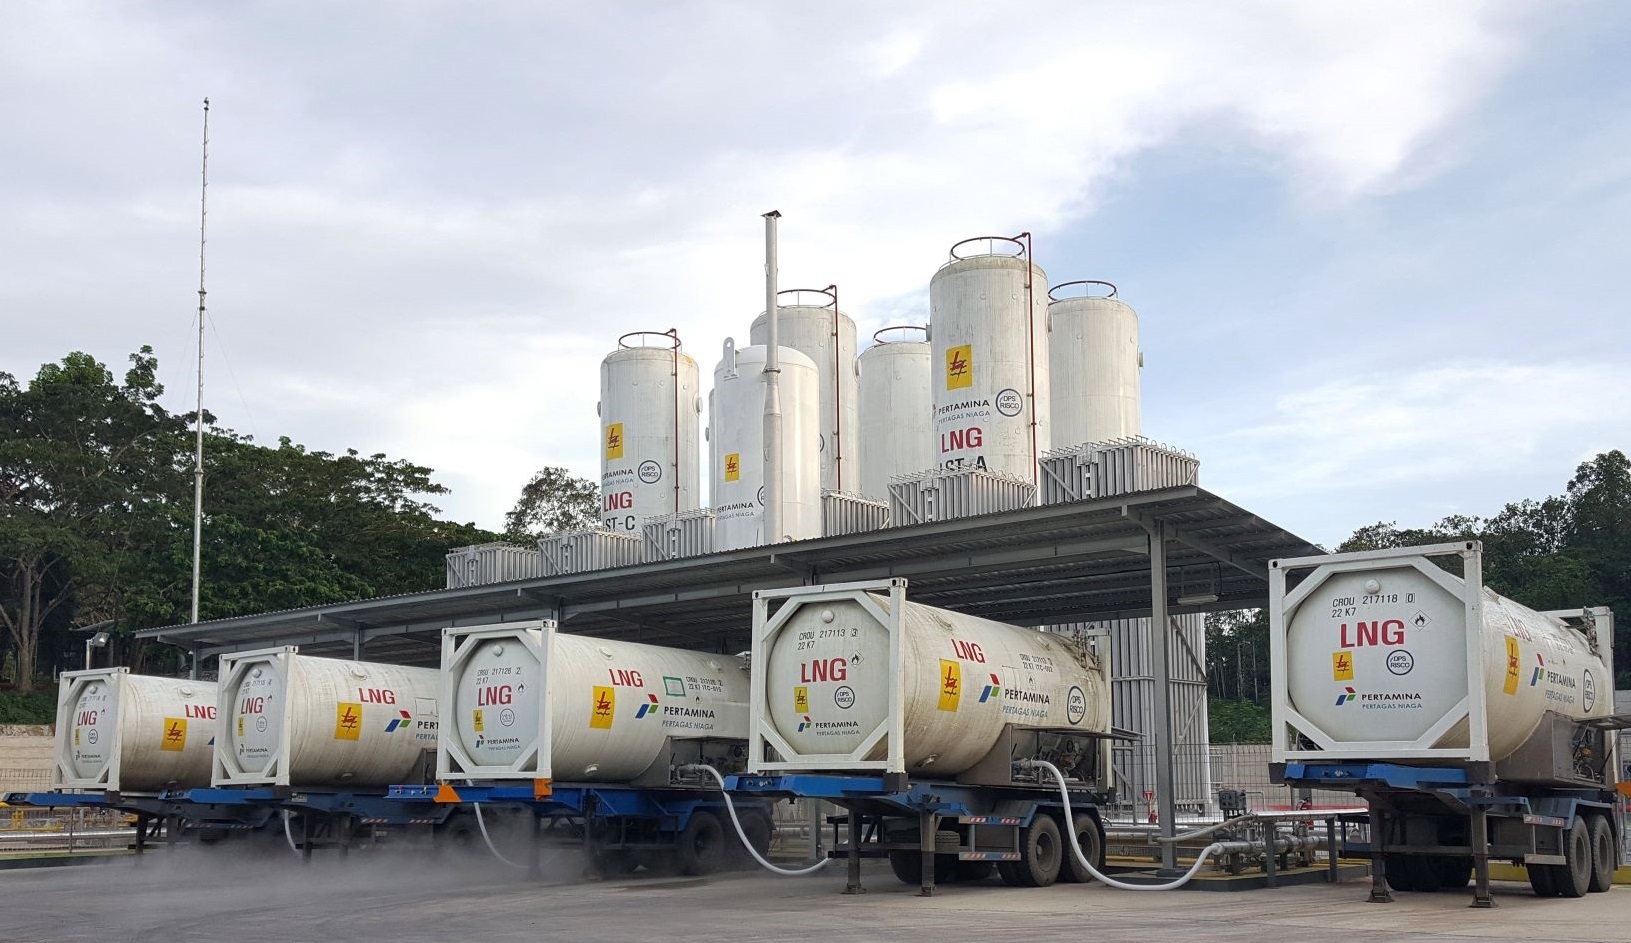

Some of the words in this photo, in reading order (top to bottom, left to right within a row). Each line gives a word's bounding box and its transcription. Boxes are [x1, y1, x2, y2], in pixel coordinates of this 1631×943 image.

[938, 400, 990, 415] PERTAMINA
[942, 427, 982, 454] LNG
[604, 491, 632, 512] LNG
[1332, 597, 1355, 608] CROU
[1362, 594, 1398, 604] 217118
[1332, 609, 1342, 618] 22
[1345, 608, 1356, 617] K7
[798, 631, 814, 641] CROU
[819, 629, 845, 638] 217113
[1340, 620, 1405, 648] LNG
[798, 642, 806, 650] 22
[806, 641, 815, 649] K7
[951, 638, 985, 664] LNG
[609, 668, 644, 687] LNG
[801, 658, 847, 683] LNG
[1547, 671, 1576, 689] PERTAMINA
[358, 687, 396, 705] LNG
[478, 685, 512, 706] LNG
[1004, 689, 1050, 704] PERTAMINA
[185, 704, 216, 720] LNG
[241, 697, 263, 714] LNG
[664, 706, 715, 718] PERTAMINA
[1002, 706, 1030, 716] PERTAGAS
[1031, 708, 1048, 718] NIAGA
[77, 710, 97, 726] LNG
[662, 720, 693, 729] PERTAGAS
[694, 722, 714, 730] NIAGA
